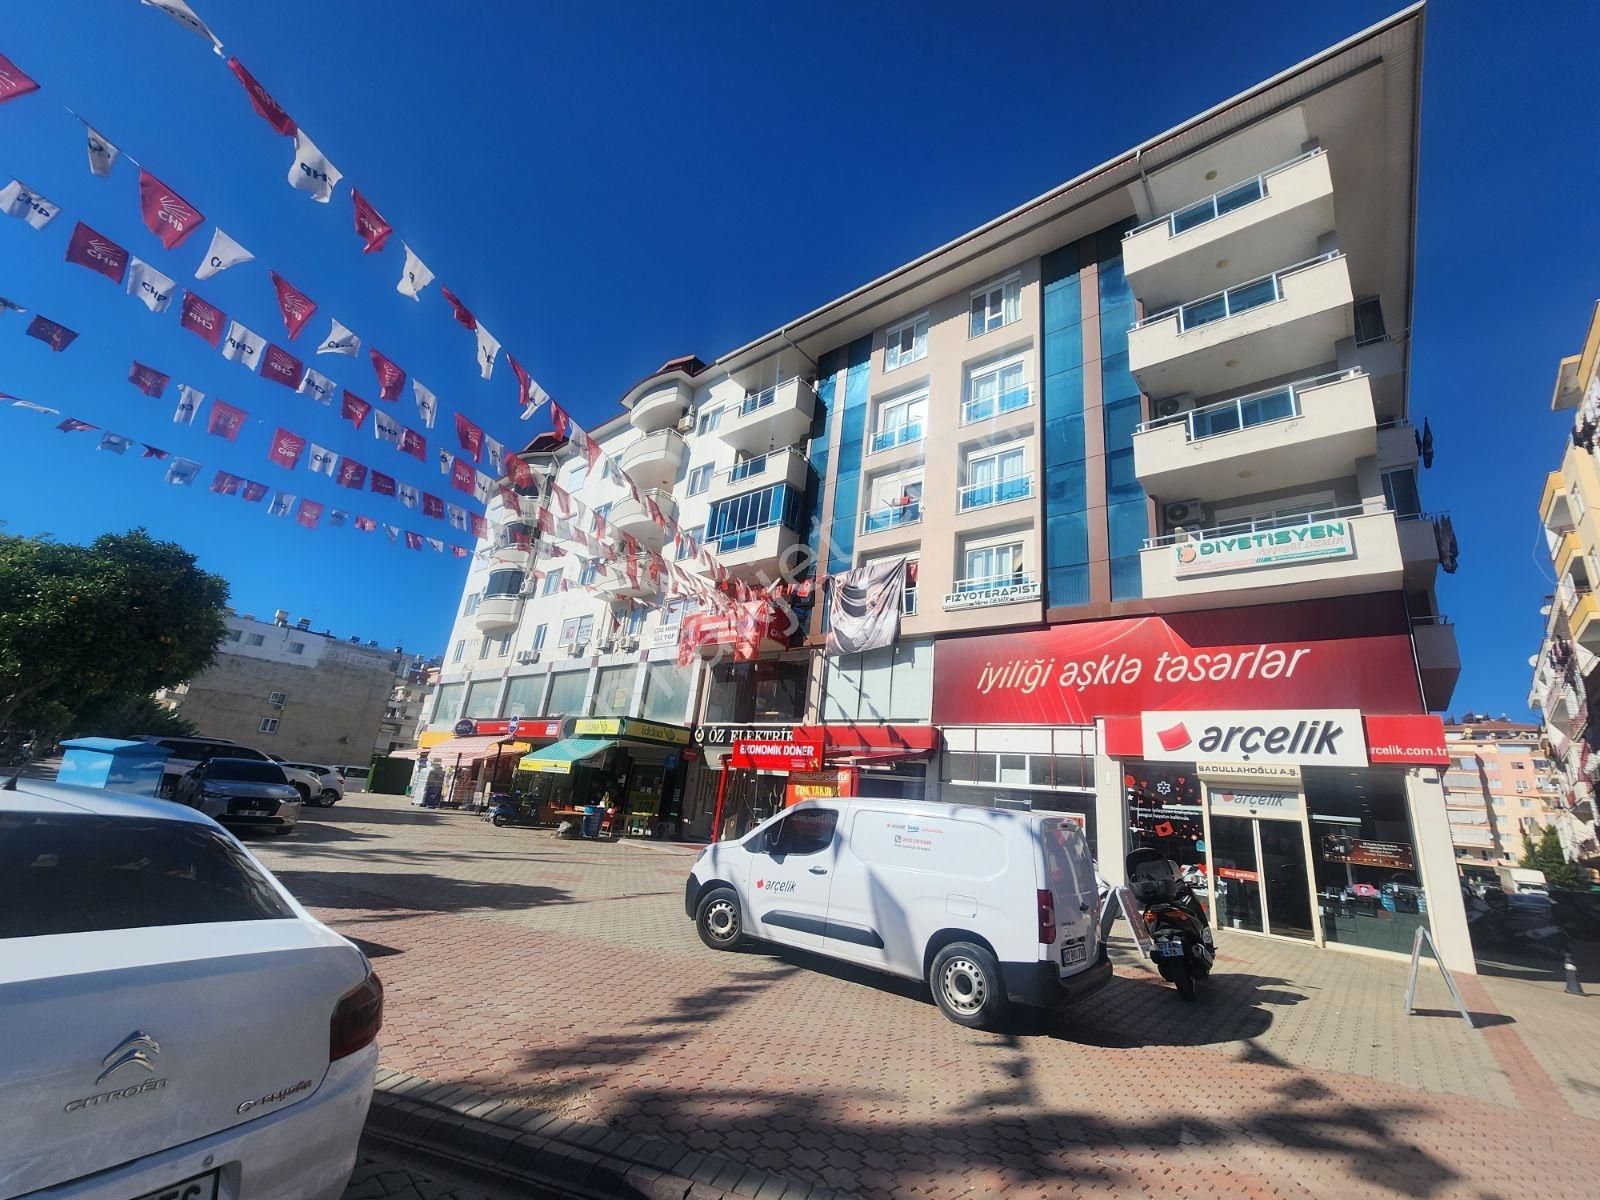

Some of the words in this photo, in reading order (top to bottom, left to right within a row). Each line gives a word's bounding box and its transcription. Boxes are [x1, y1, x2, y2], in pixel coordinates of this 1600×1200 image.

[16, 193, 50, 217] CHP
[158, 210, 184, 231] CHP
[87, 249, 119, 267] CHP
[142, 282, 167, 301] CHP
[278, 447, 296, 458] CHP
[314, 454, 332, 464] CHP
[977, 657, 1055, 694] iyiliği
[1059, 651, 1142, 692] aşkla
[1153, 644, 1311, 684] tasarlar
[641, 726, 664, 738] iddaa
[709, 727, 725, 743] ÖZ
[730, 727, 794, 741] ELEKTRİK
[1199, 720, 1344, 761] arçelik
[740, 743, 782, 756] EKONOMİK
[783, 744, 815, 757] DÖNER
[1199, 765, 1277, 776] SADULLAHOĞLU
[1234, 792, 1285, 807] arçelik
[766, 880, 796, 893] arçelik
[64, 1077, 168, 1113] CITROËN
